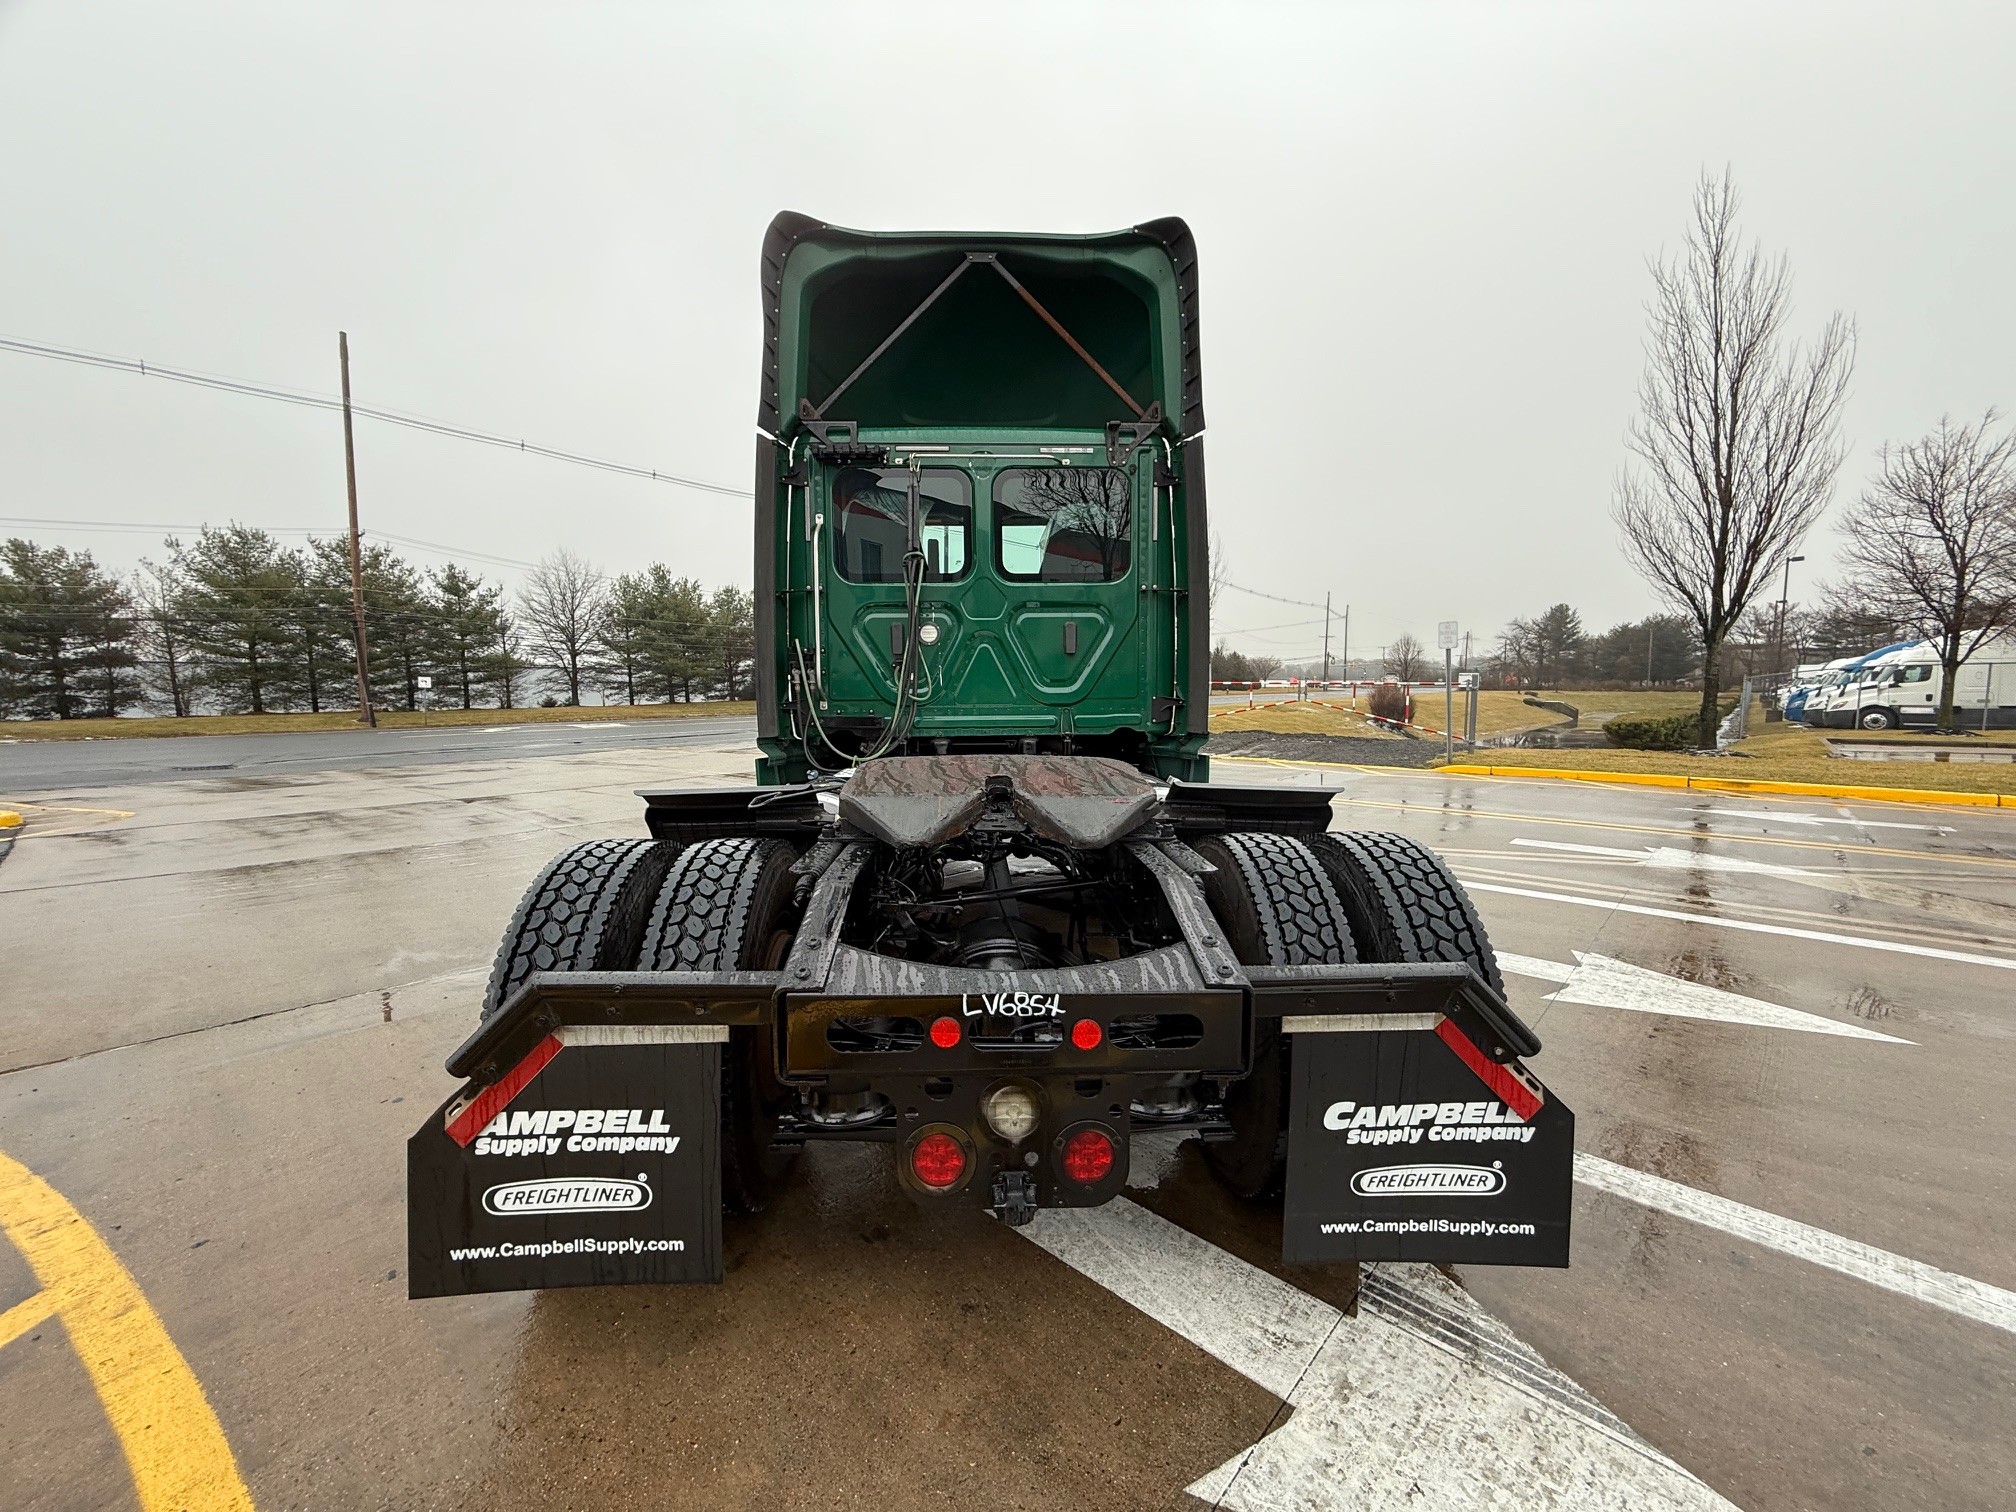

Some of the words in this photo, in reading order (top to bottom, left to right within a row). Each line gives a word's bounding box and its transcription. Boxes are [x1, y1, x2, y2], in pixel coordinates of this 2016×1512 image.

[962, 991, 1067, 1017] LV6854
[476, 1109, 672, 1137] AMPBELL
[474, 1134, 562, 1157] Supply
[566, 1135, 681, 1155] Company
[1346, 1126, 1424, 1146] Supply
[1428, 1125, 1536, 1144] Company
[1366, 1172, 1489, 1189] FREIGHTLINER
[501, 1187, 634, 1207] FREIGHTLINER
[1320, 1219, 1535, 1236] www.CampbellSupply.com
[449, 1237, 685, 1261] www.CampbellSupply.com
